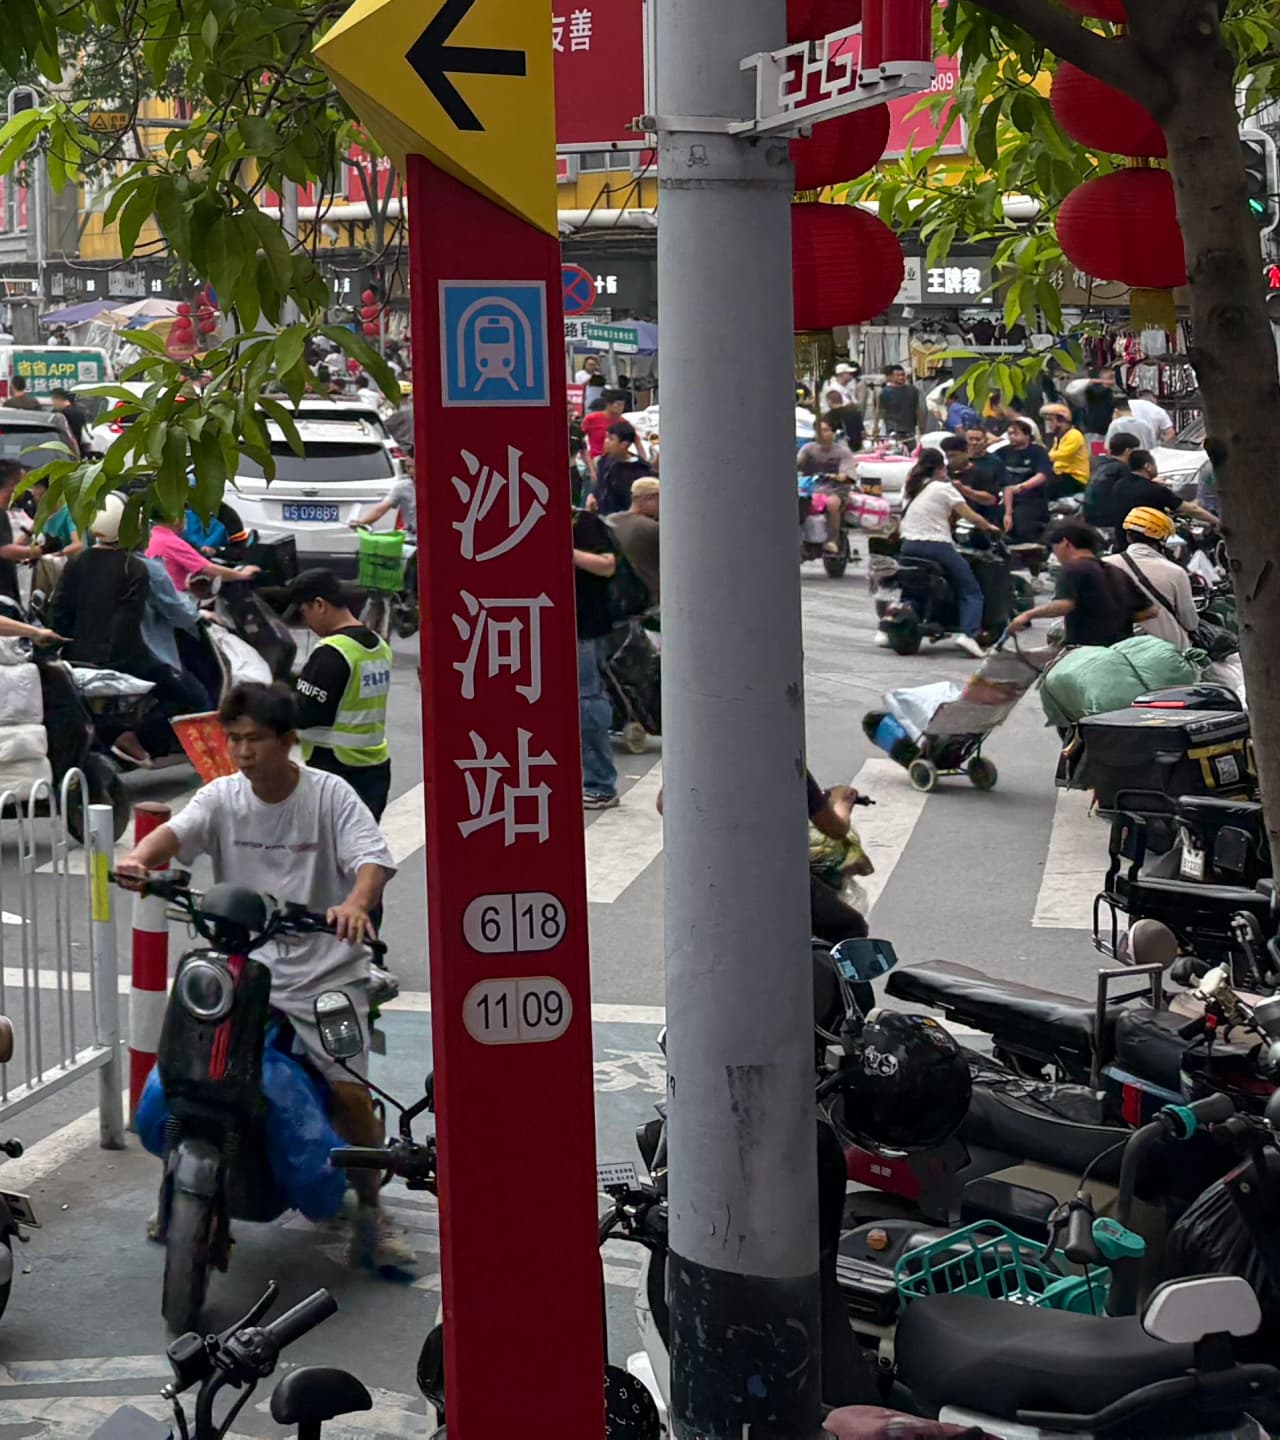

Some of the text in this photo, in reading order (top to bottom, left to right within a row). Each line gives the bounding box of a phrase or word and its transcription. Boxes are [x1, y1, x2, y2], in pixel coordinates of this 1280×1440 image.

[18, 360, 76, 377] 省省APP
[452, 444, 557, 847] 沙河站
